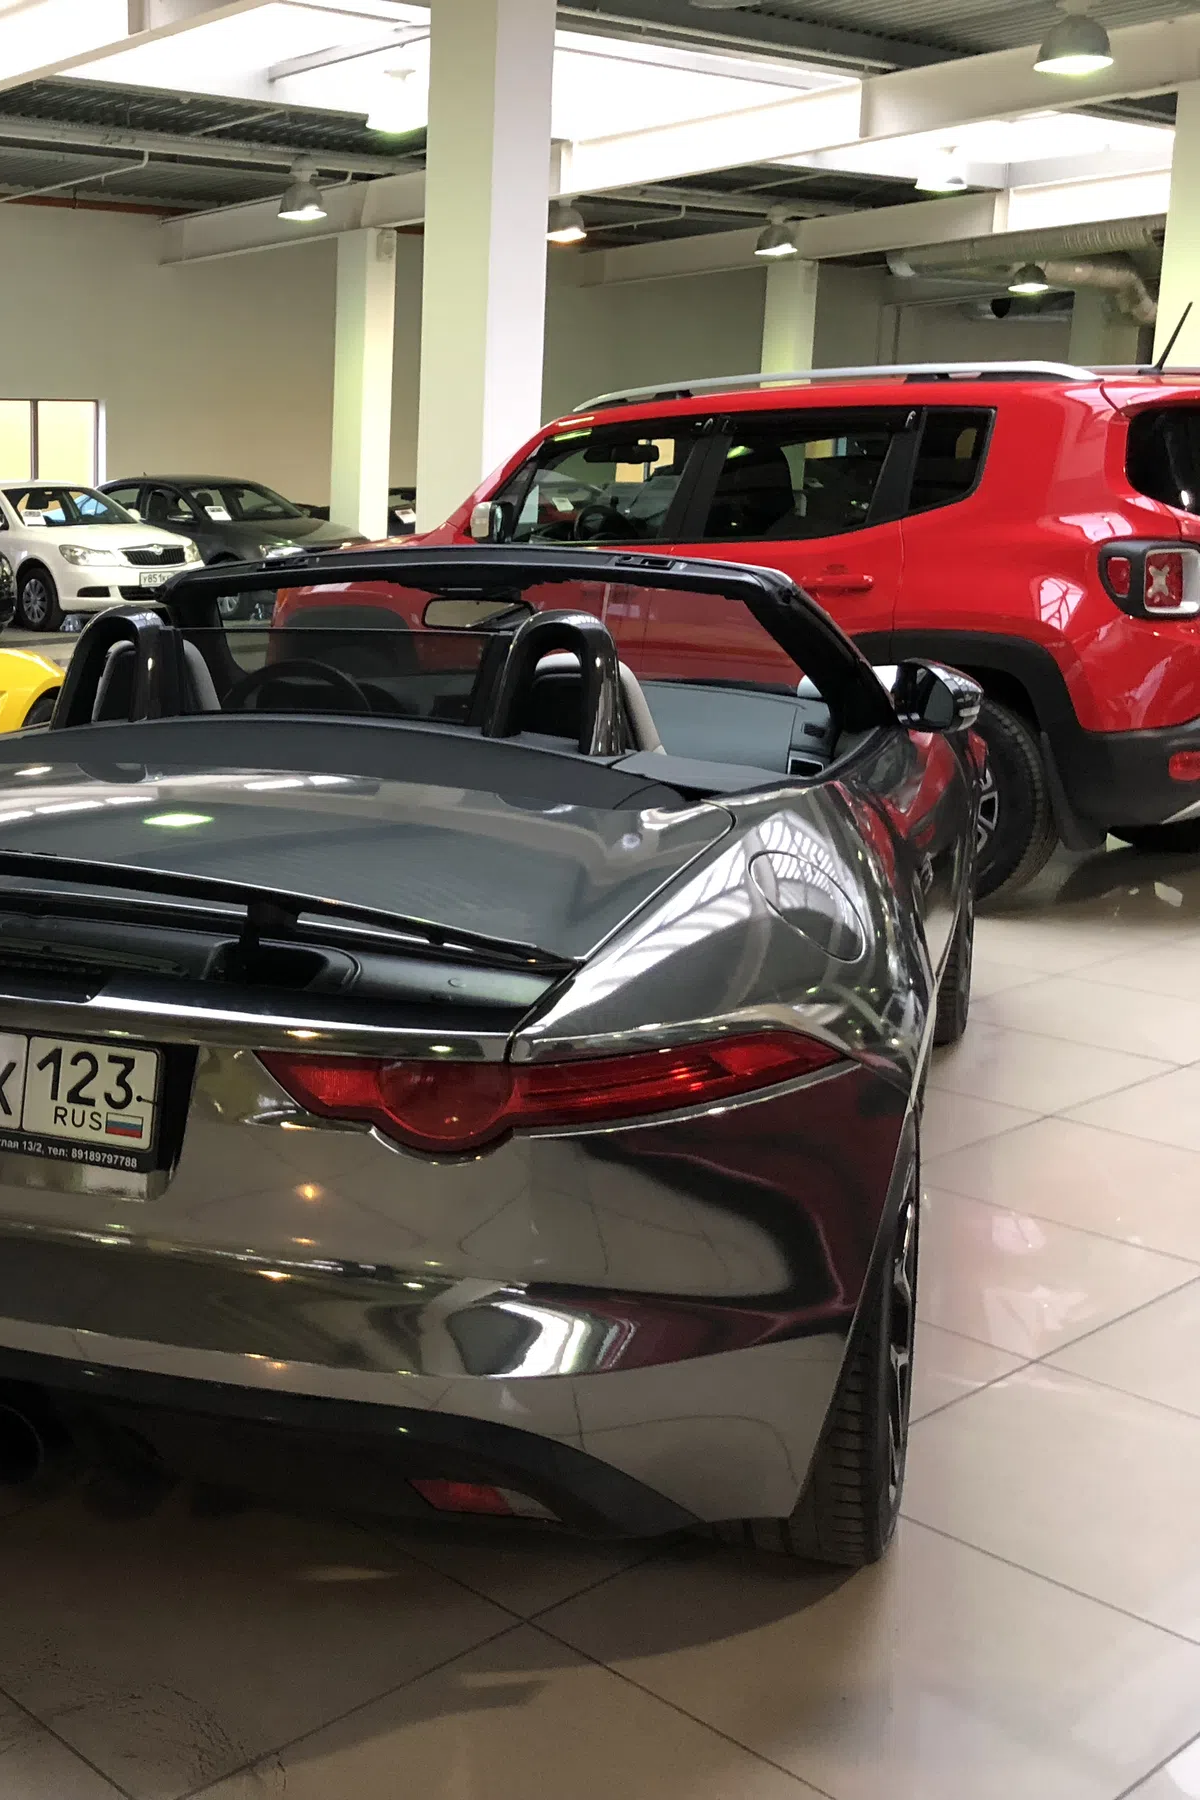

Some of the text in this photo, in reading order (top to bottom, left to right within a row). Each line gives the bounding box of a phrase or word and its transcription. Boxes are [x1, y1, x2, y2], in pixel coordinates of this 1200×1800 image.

[36, 1047, 136, 1110] 123
[53, 1106, 103, 1131] RUS
[22, 1141, 45, 1155] 13/2,
[48, 1146, 68, 1158] тел:
[71, 1148, 138, 1169] 89189797788
